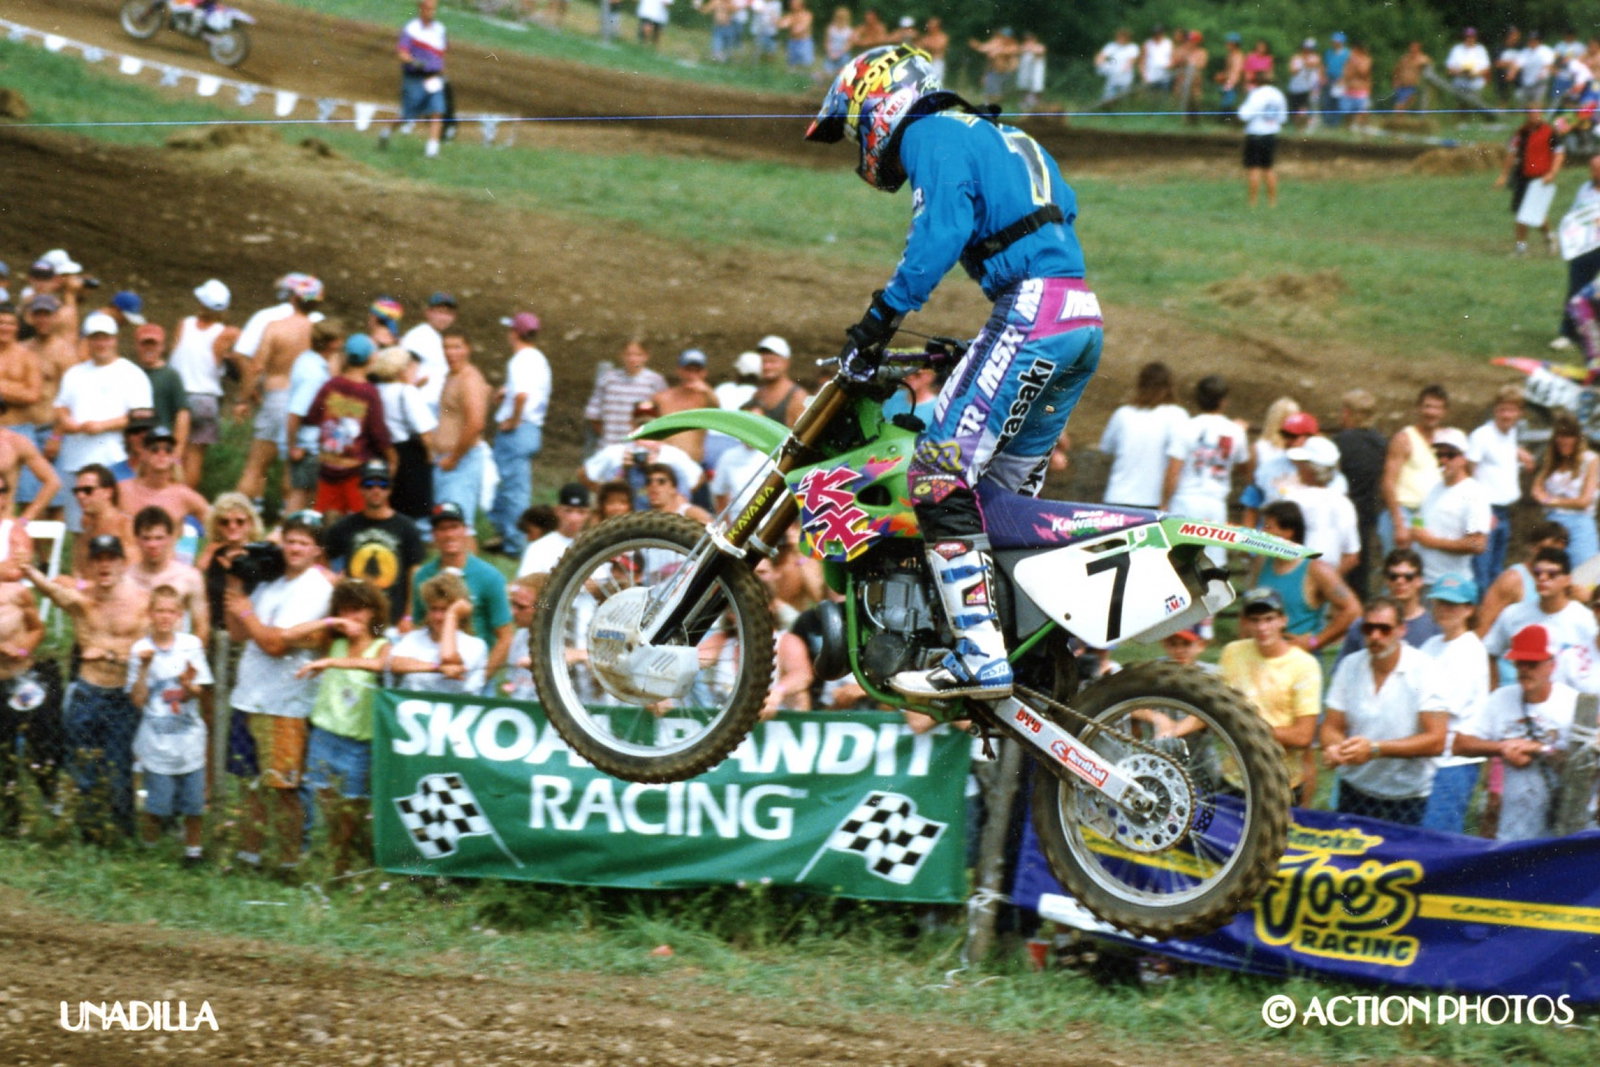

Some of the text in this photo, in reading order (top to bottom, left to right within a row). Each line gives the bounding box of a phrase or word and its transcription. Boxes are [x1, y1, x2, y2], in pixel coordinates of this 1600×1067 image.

[1051, 513, 1124, 532] Kawasaki
[1179, 523, 1237, 543] MOTUL
[1085, 551, 1131, 643] 7
[527, 774, 794, 840] RACING
[1301, 929, 1412, 961] RACING
